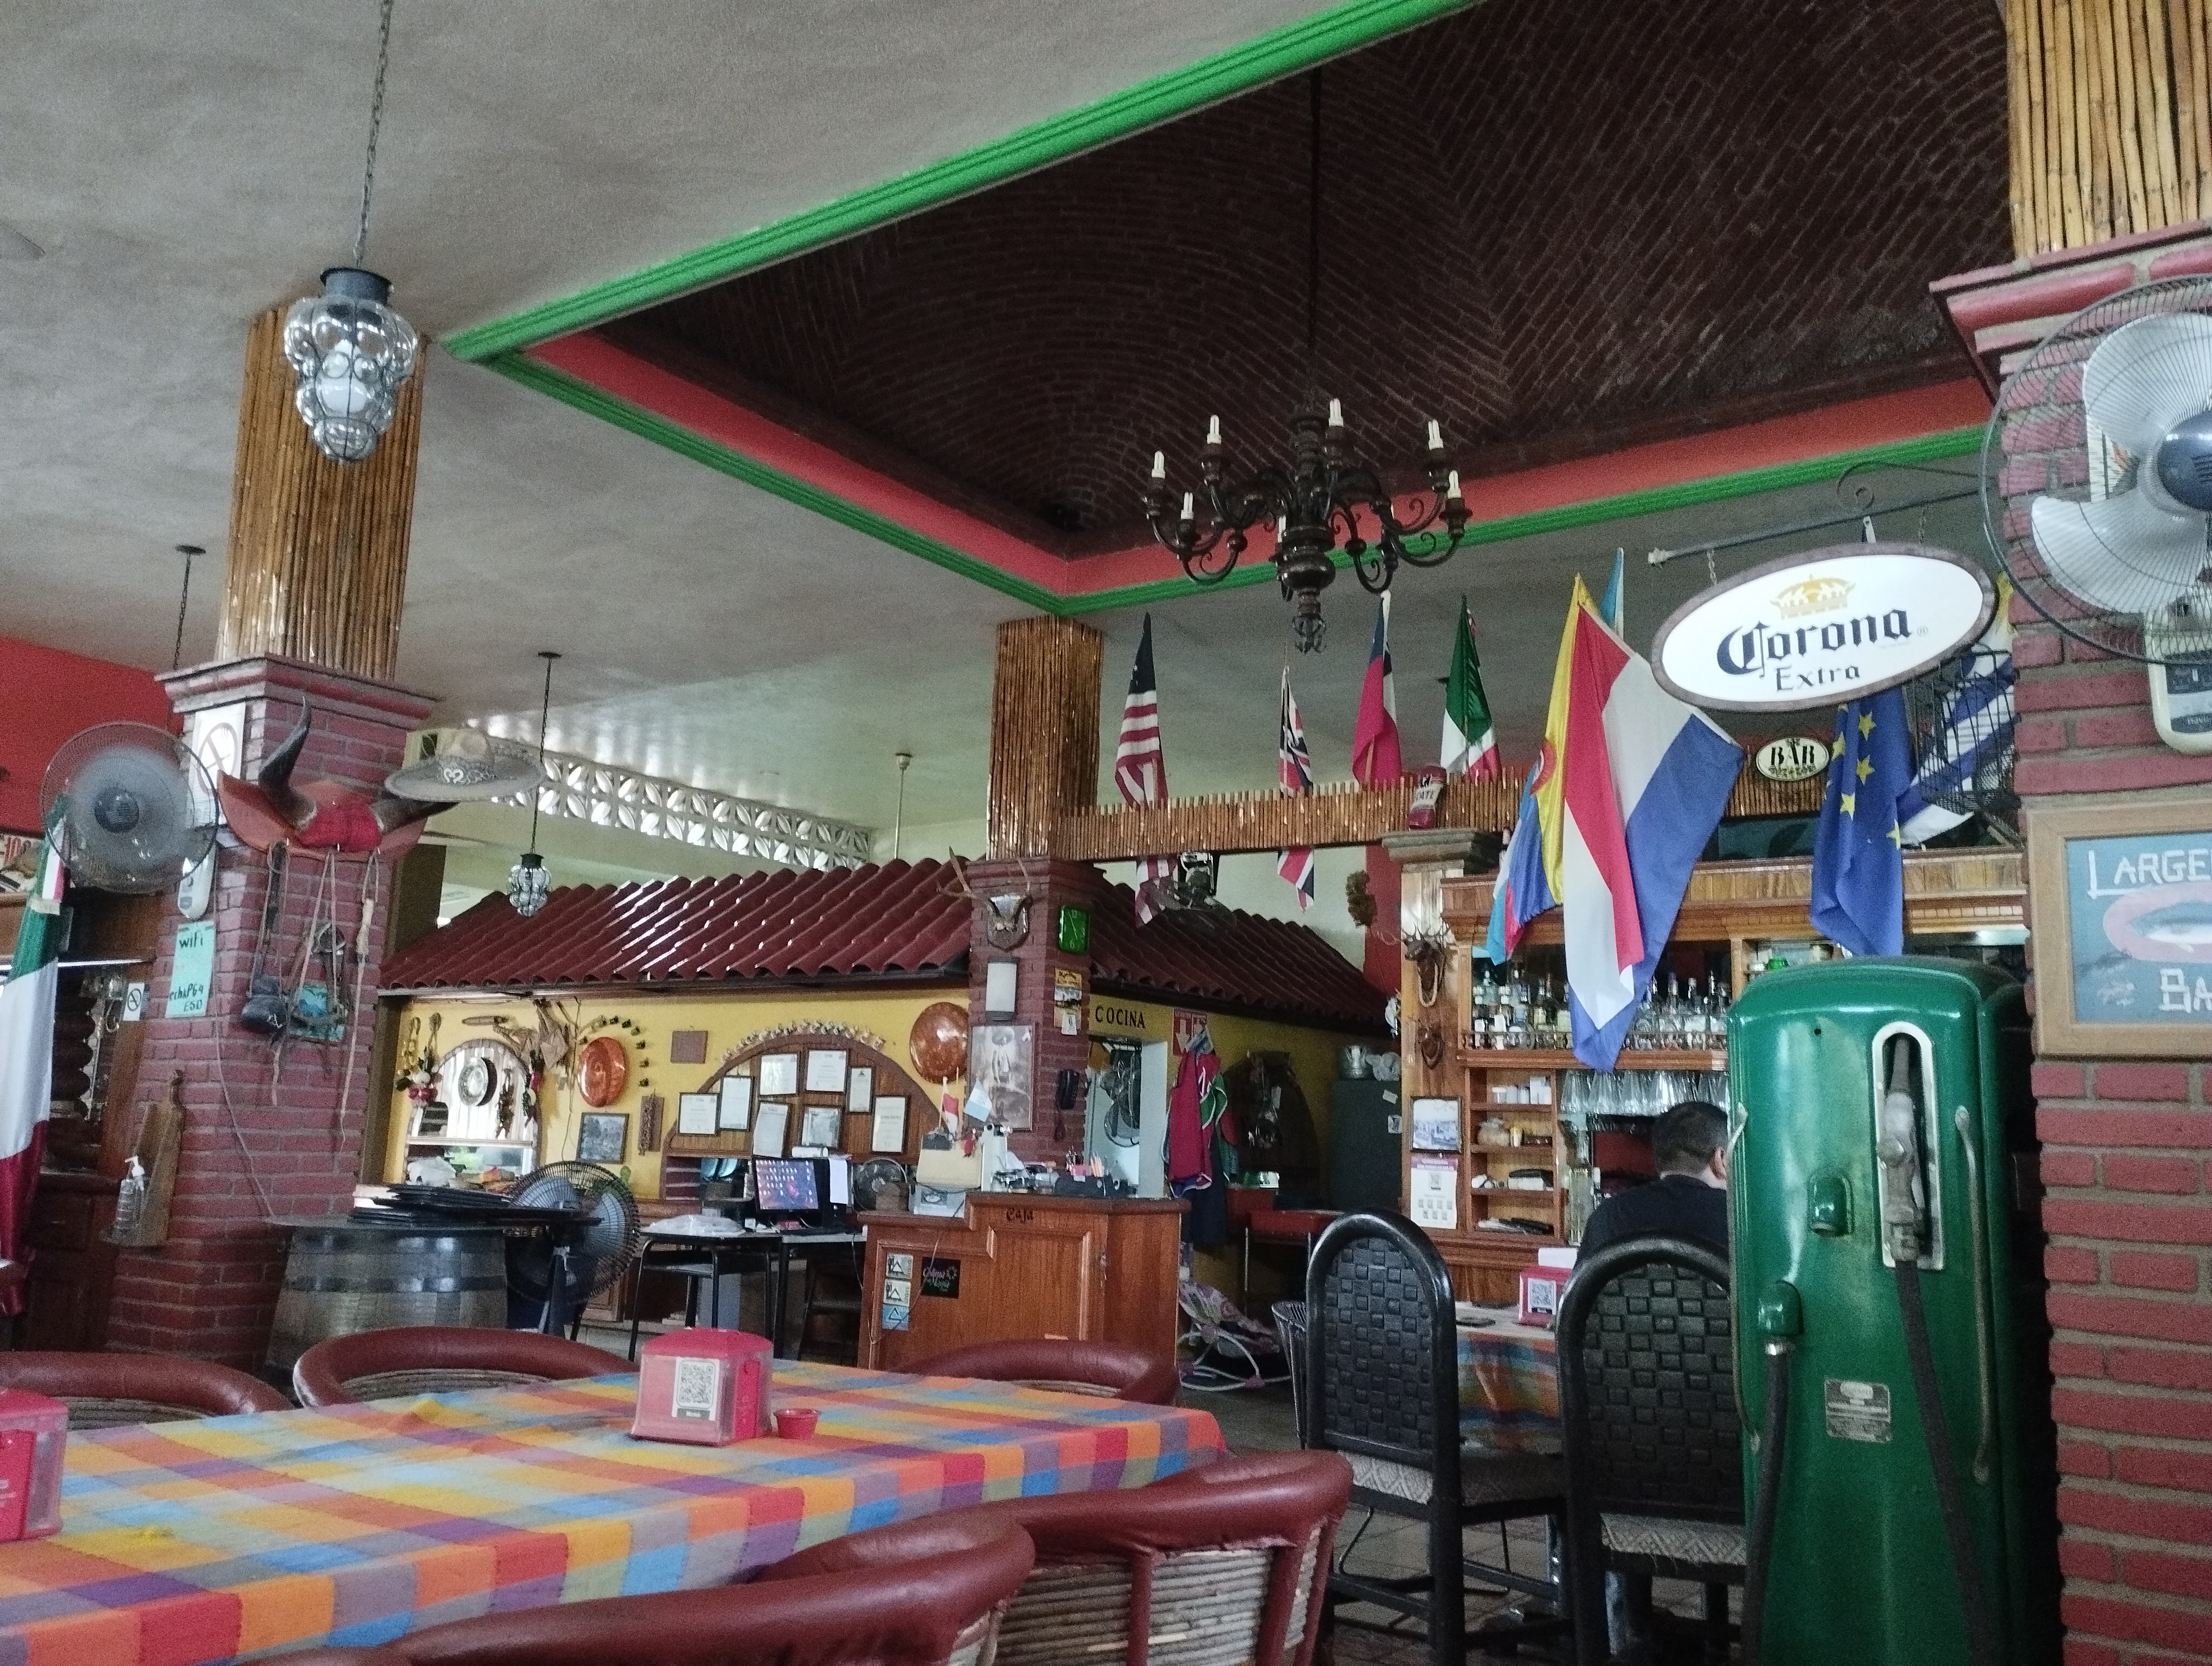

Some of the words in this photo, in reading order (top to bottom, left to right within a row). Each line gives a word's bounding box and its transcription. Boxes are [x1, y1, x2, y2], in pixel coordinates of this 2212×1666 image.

[1716, 607, 1913, 679] Corona
[1776, 664, 1860, 692] Extra
[1771, 739, 1815, 765] BAR
[2087, 849, 2212, 899] LARGE
[1095, 1006, 1146, 1029] COCINA
